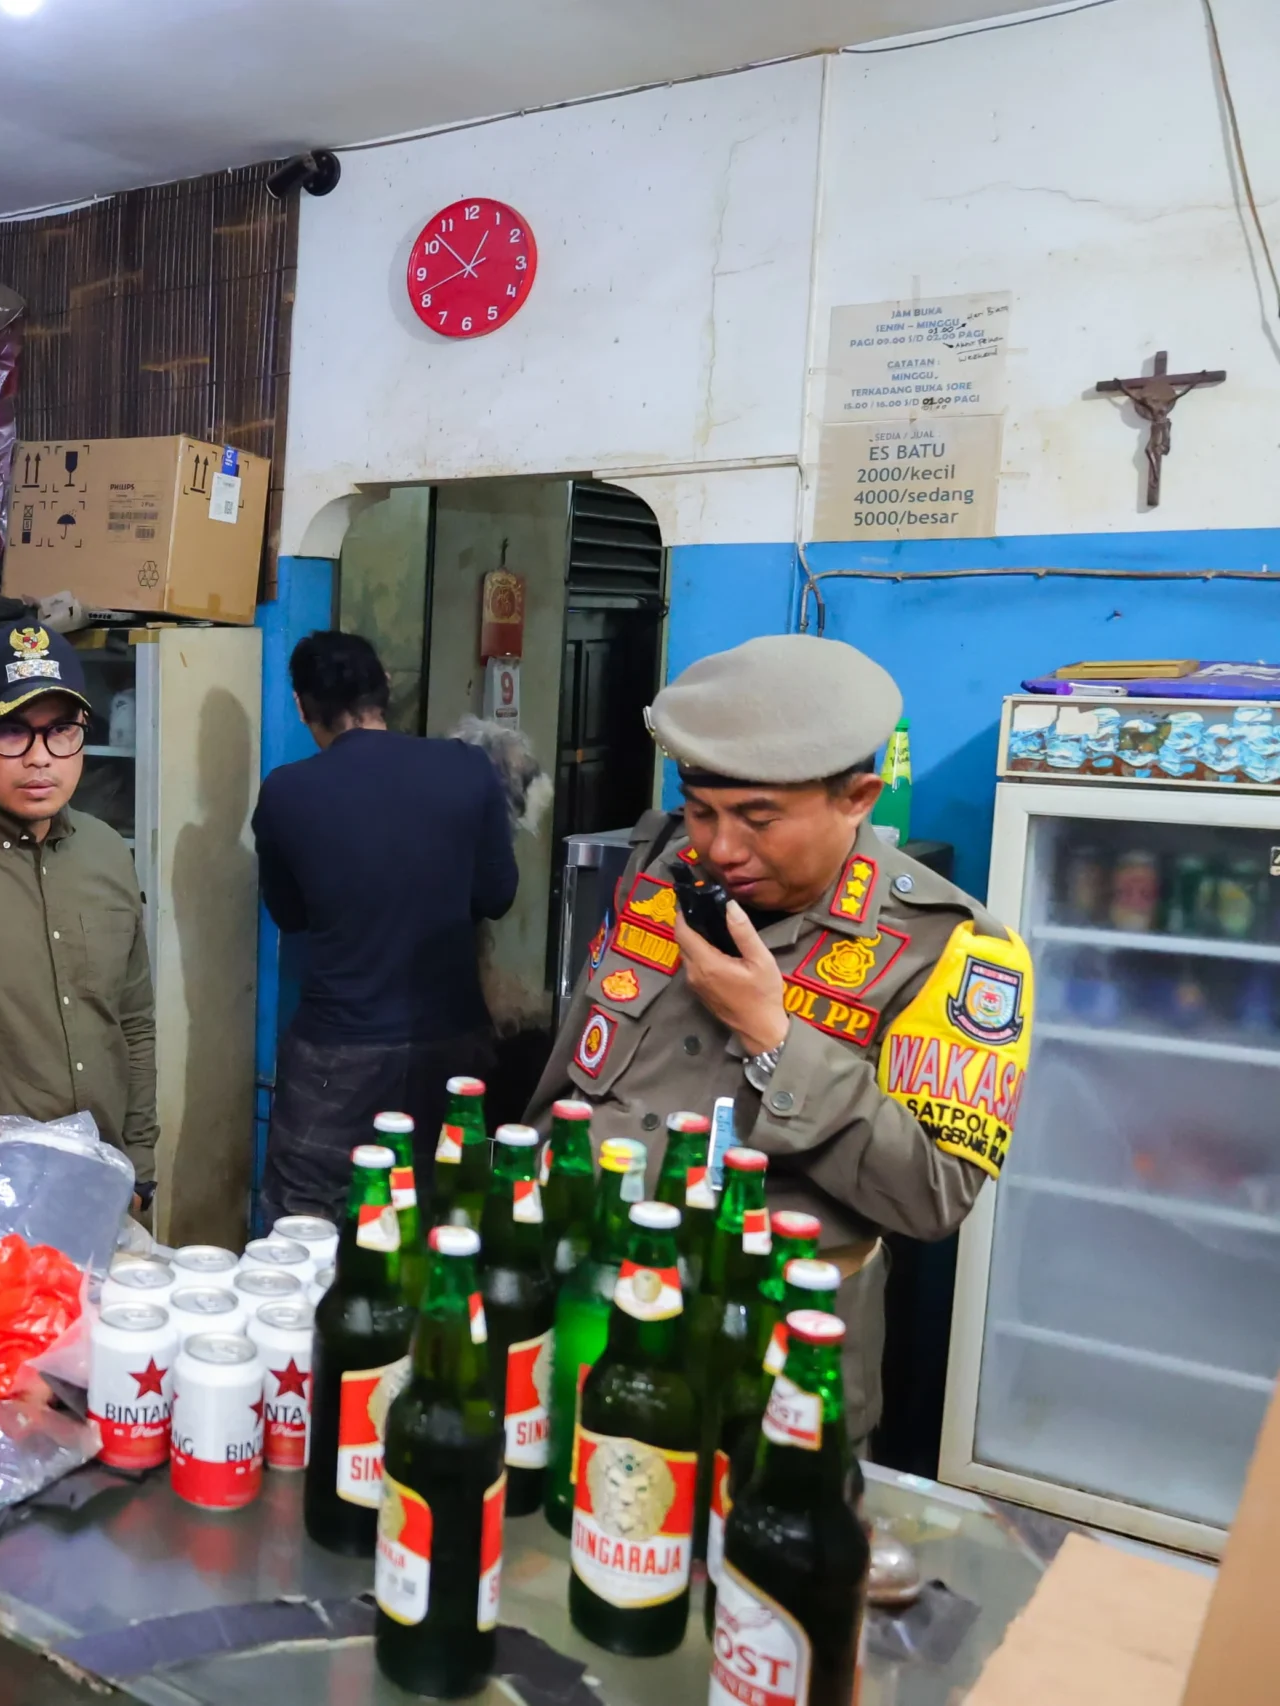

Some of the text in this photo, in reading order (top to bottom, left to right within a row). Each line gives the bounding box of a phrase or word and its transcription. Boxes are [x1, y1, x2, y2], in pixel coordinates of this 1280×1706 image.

[464, 205, 480, 221] 12
[495, 211, 501, 226] 1
[441, 218, 454, 233] 11
[509, 228, 521, 243] 2
[424, 240, 440, 255] 10
[515, 256, 527, 270] 3
[416, 268, 427, 281] 9
[506, 284, 516, 298] 4
[421, 294, 432, 308] 8
[438, 311, 448, 325] 7
[487, 306, 498, 320] 5
[891, 307, 942, 320] JAM BUKA
[461, 317, 472, 331] 6
[876, 323, 905, 333] SENIN
[916, 318, 960, 329] MINGGU
[849, 338, 875, 348] PAGI
[908, 333, 924, 343] S/D
[958, 329, 985, 339] PAGI
[887, 358, 936, 369] CATATAN
[851, 381, 973, 397] TERKADANG BUKA SORE
[954, 394, 980, 404] PAGI
[874, 432, 901, 441] SEDIA
[910, 430, 934, 440] JUAL
[869, 443, 945, 461] ES BATU
[857, 464, 956, 483] 2000/kecil
[109, 483, 135, 491] PHILIPS
[853, 486, 974, 505] 4000/sedang
[853, 510, 959, 527] 5000/besar
[783, 982, 871, 1036] OL PP
[906, 1099, 990, 1139] SATPOL
